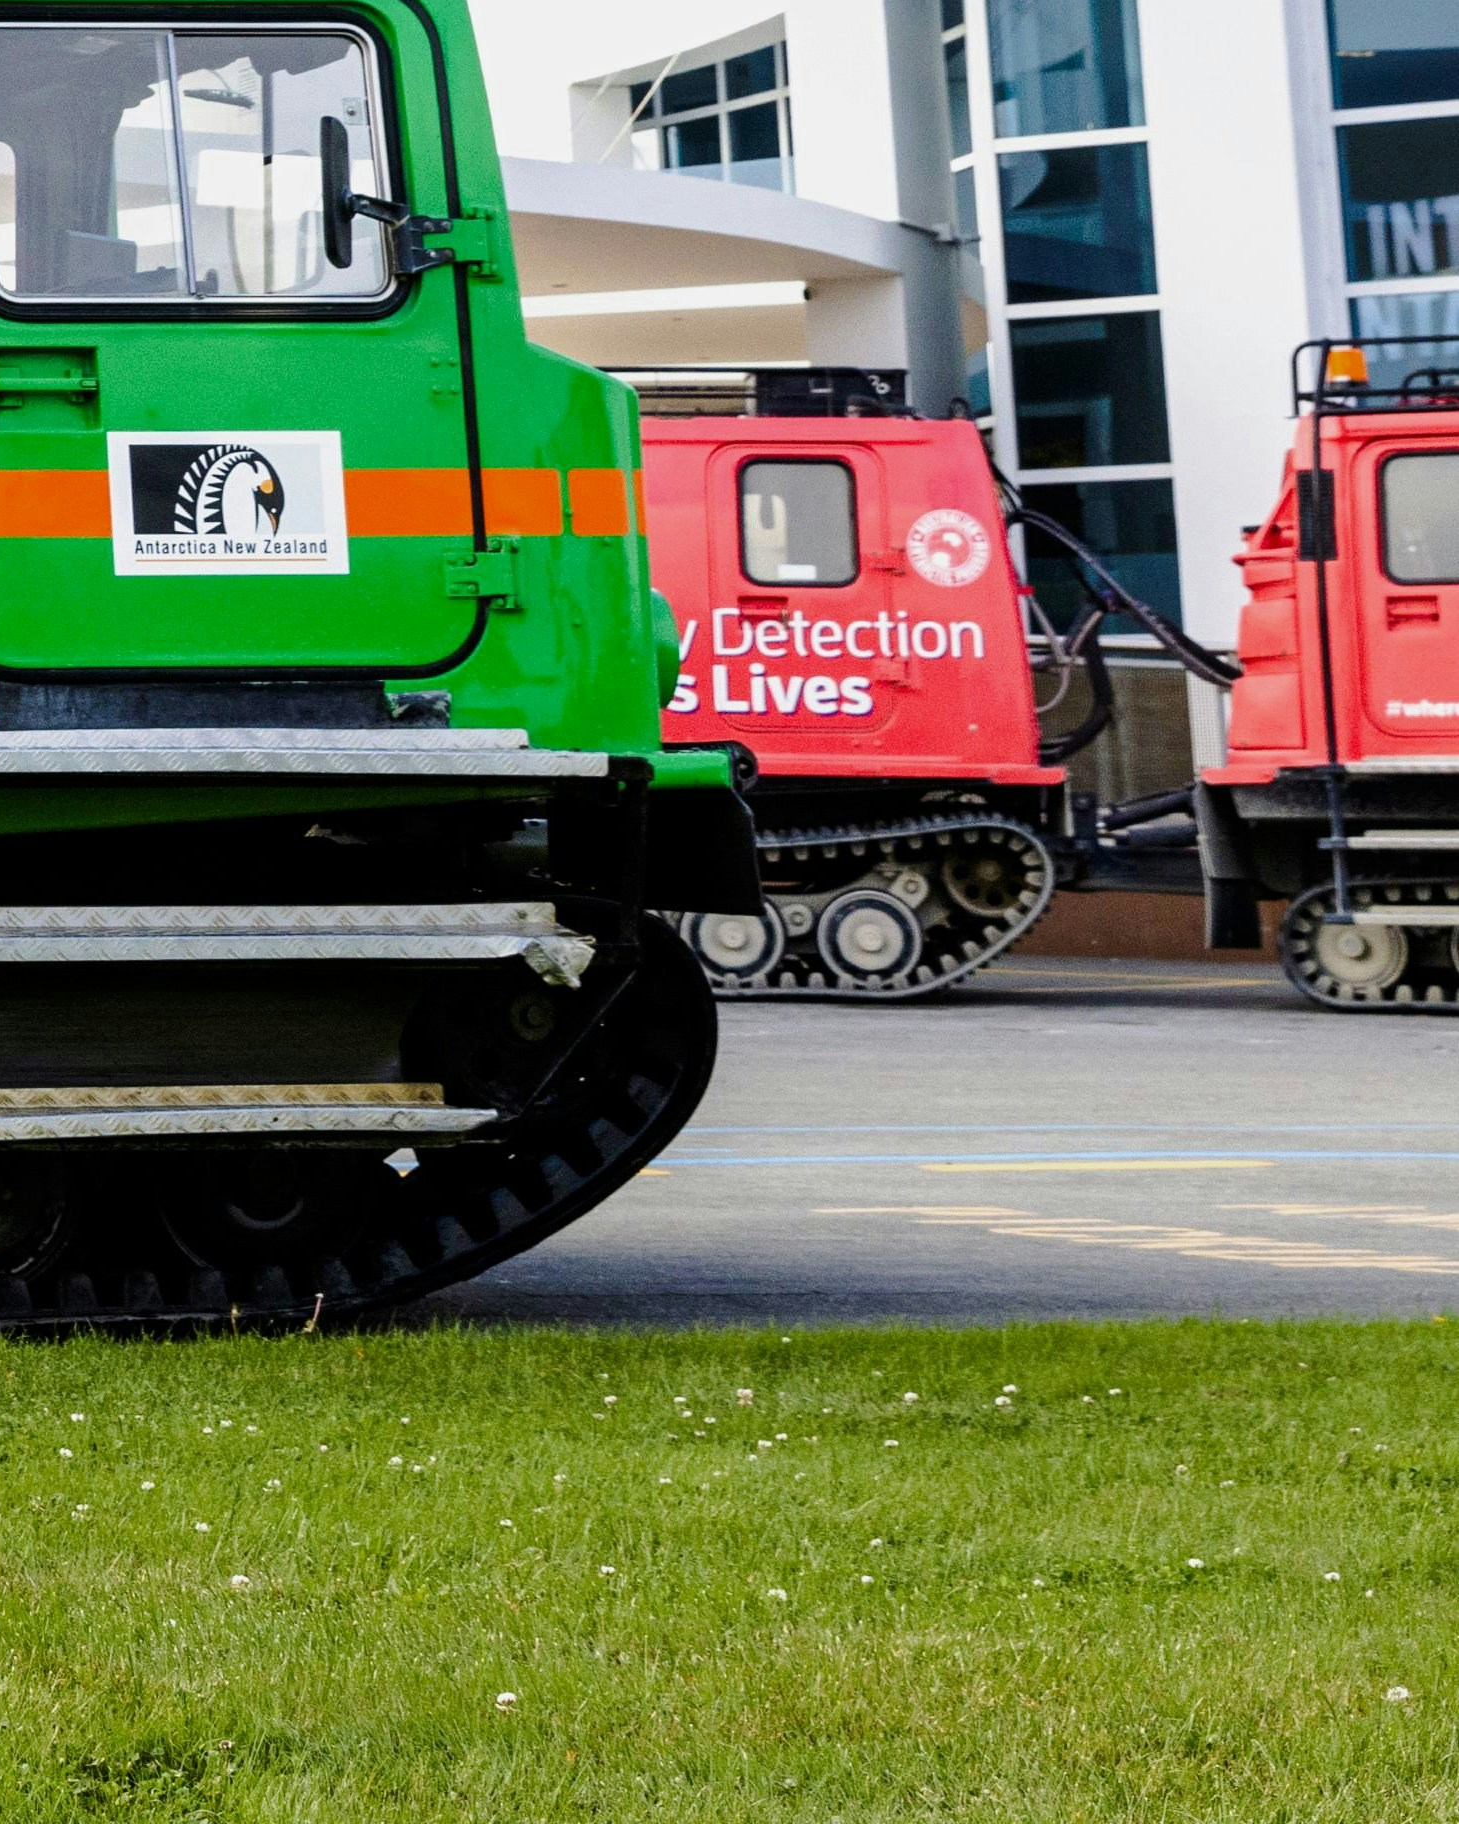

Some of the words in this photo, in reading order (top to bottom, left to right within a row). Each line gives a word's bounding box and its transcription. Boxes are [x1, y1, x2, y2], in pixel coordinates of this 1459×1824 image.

[134, 539, 217, 555] Antarctica
[223, 539, 257, 555] New
[263, 538, 328, 555] Zealand
[711, 606, 985, 659] Detection
[711, 661, 873, 715] Lives
